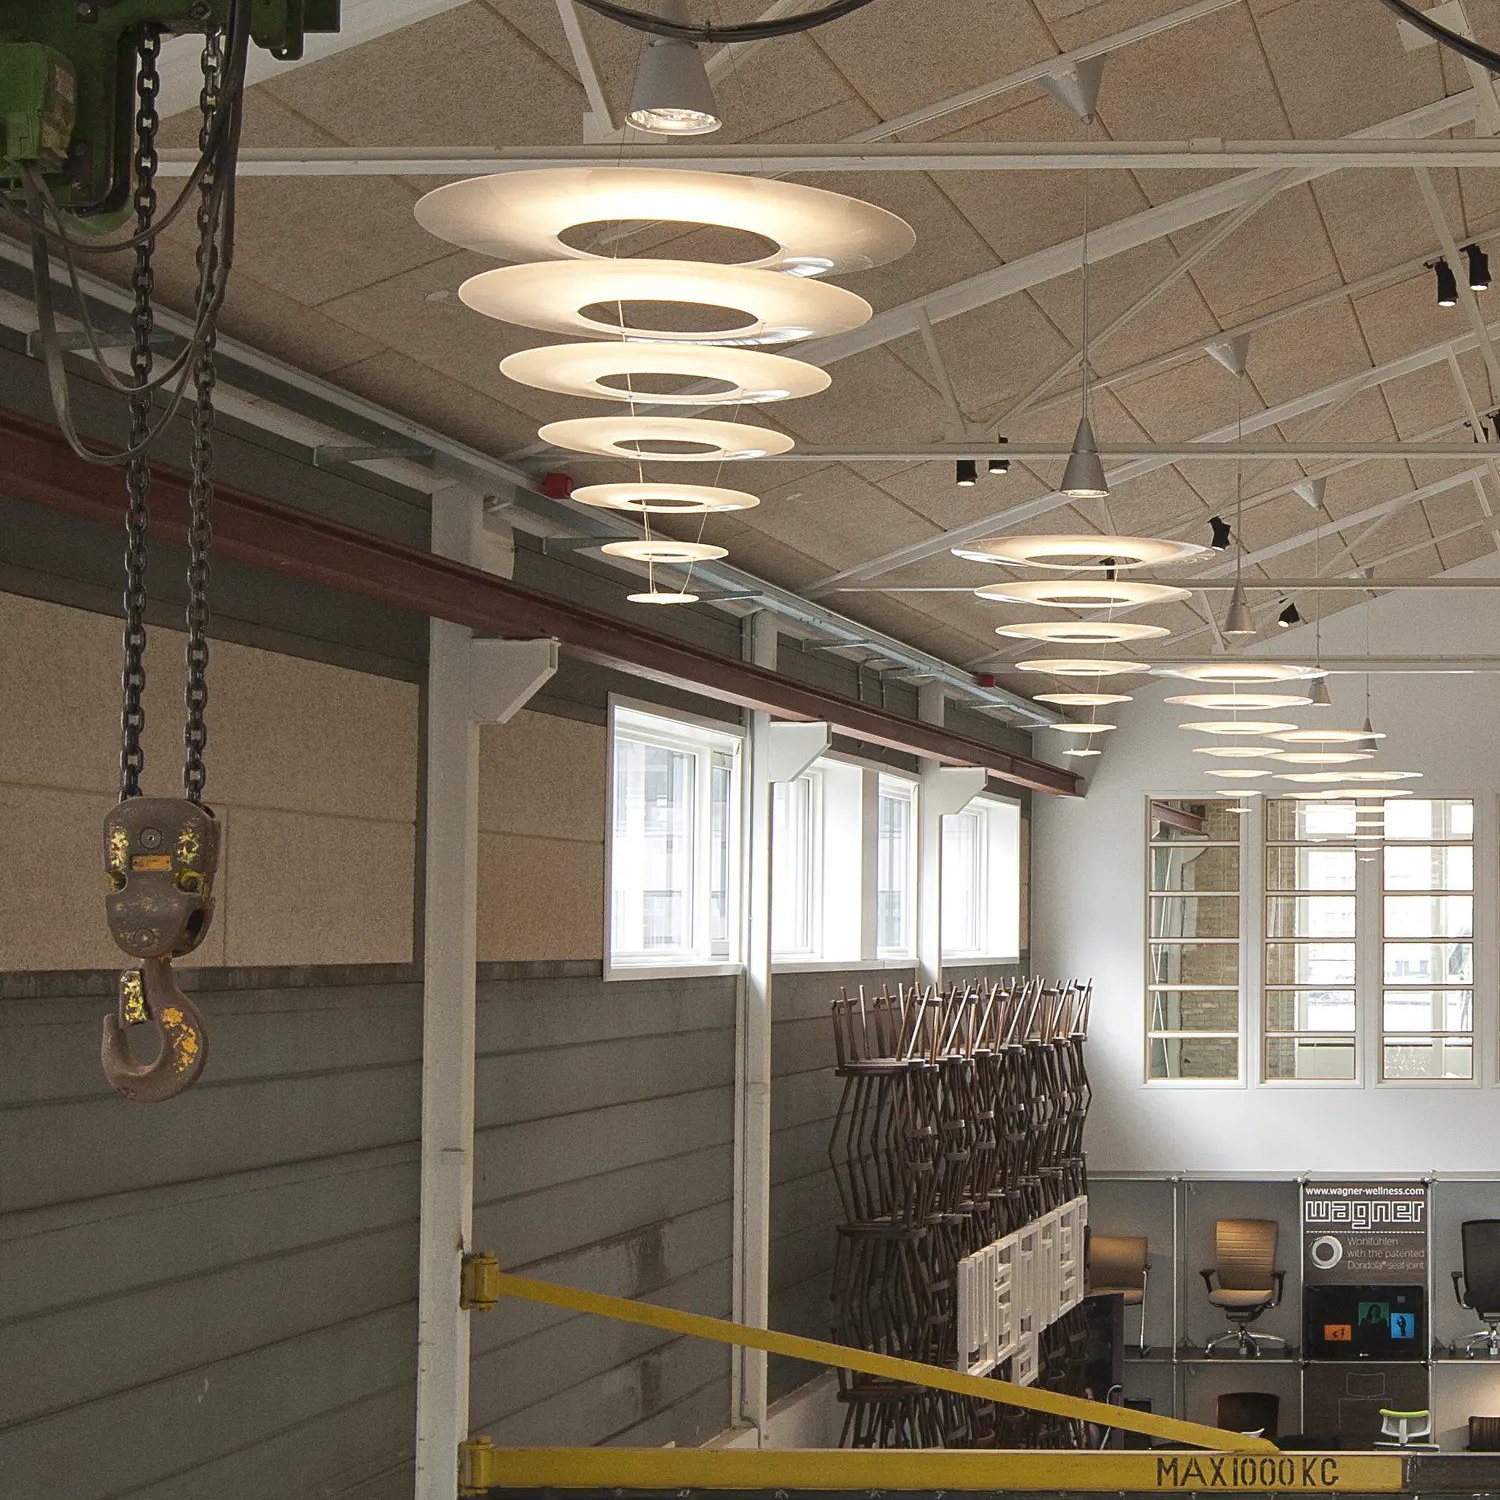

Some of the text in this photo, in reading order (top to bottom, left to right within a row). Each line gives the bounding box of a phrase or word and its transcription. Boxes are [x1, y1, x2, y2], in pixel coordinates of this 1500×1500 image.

[1305, 1187, 1425, 1197] www.wagner-wellness.com
[1305, 1200, 1425, 1230] wagner
[1347, 1248, 1425, 1260] with the patented
